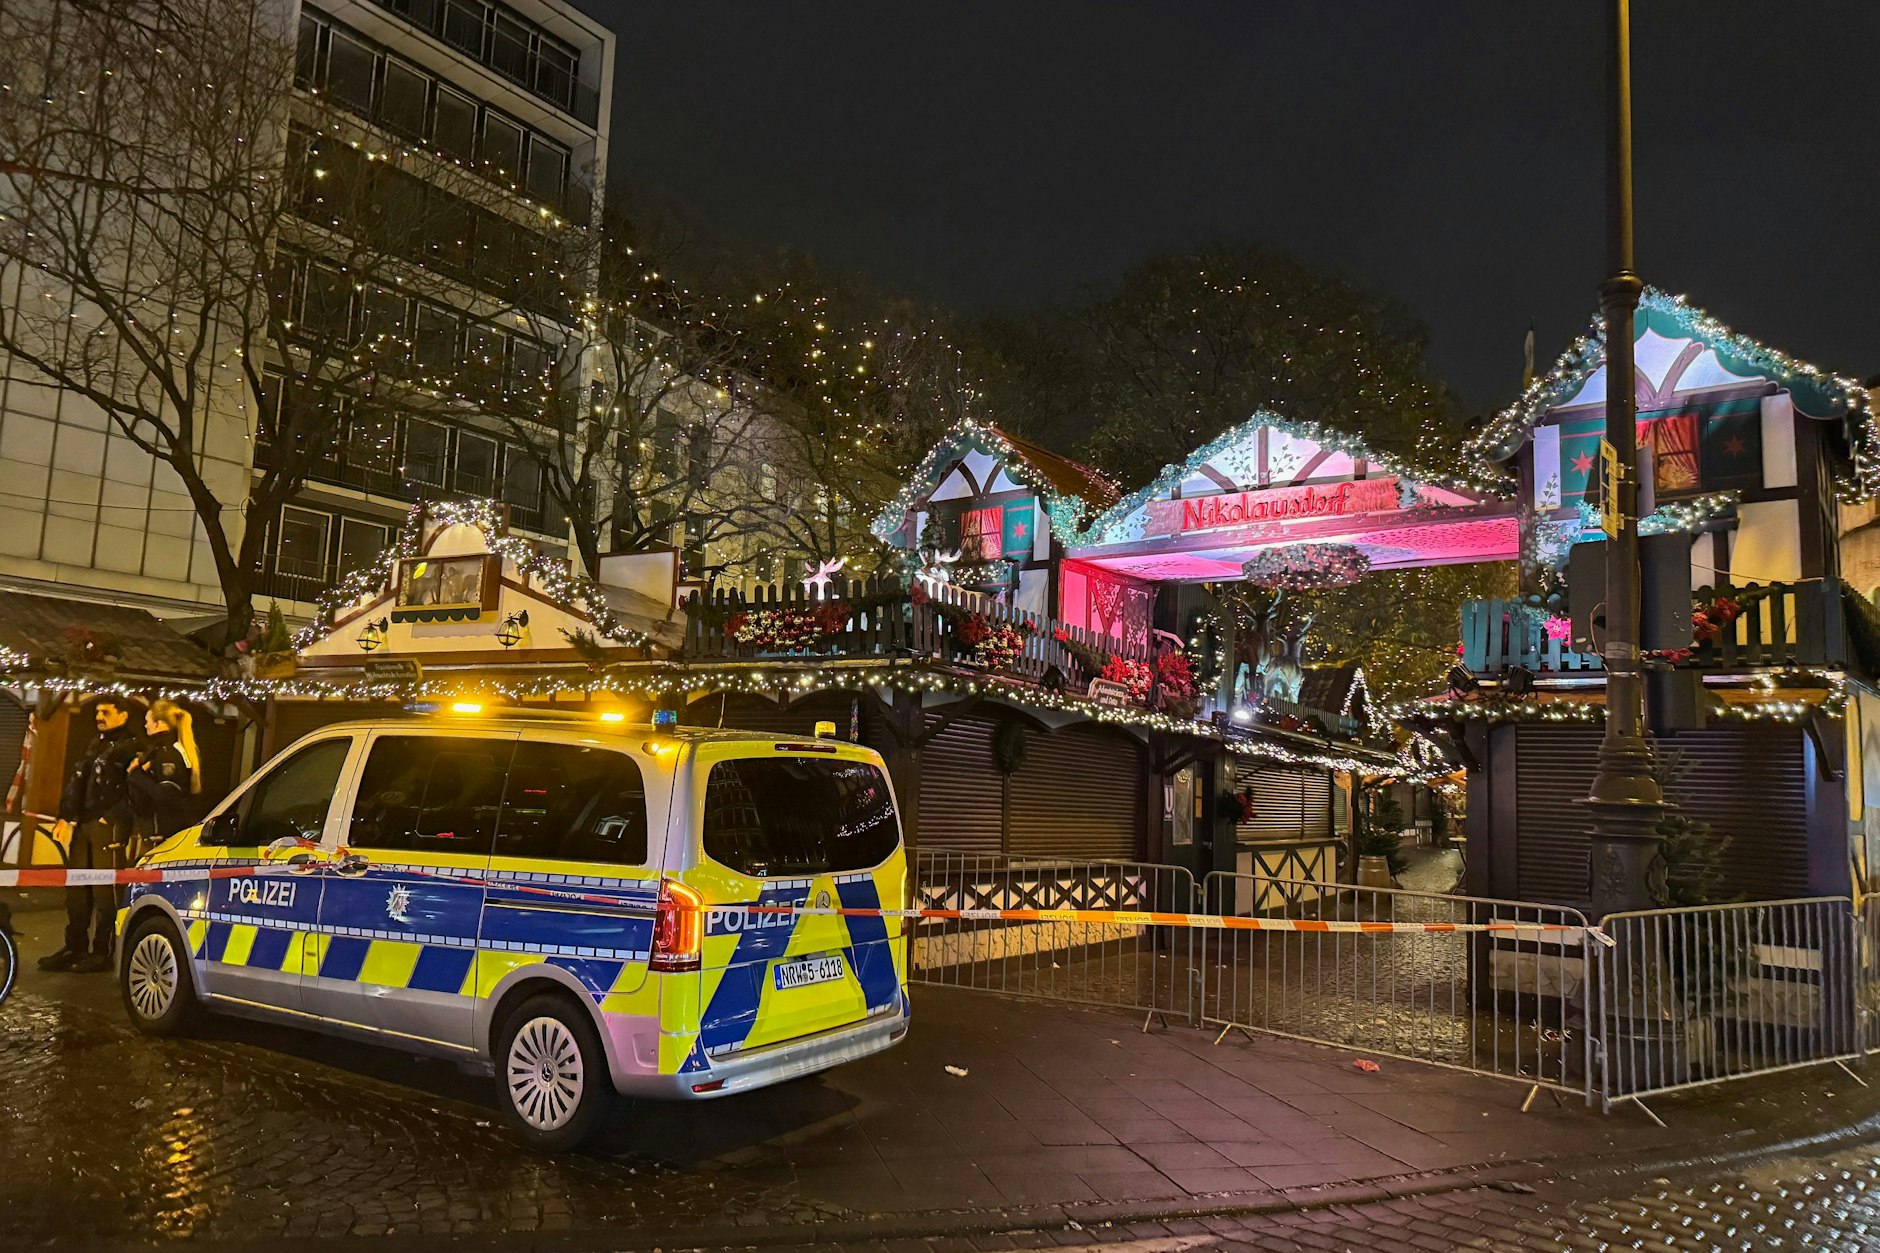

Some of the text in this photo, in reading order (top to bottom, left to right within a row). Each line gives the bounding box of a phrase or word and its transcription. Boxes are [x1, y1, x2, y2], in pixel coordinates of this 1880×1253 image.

[1182, 482, 1354, 531] Nikolausdorf
[228, 878, 297, 907] POLIZEI
[706, 901, 797, 934] POLIZEI
[807, 959, 843, 981] 5-6118
